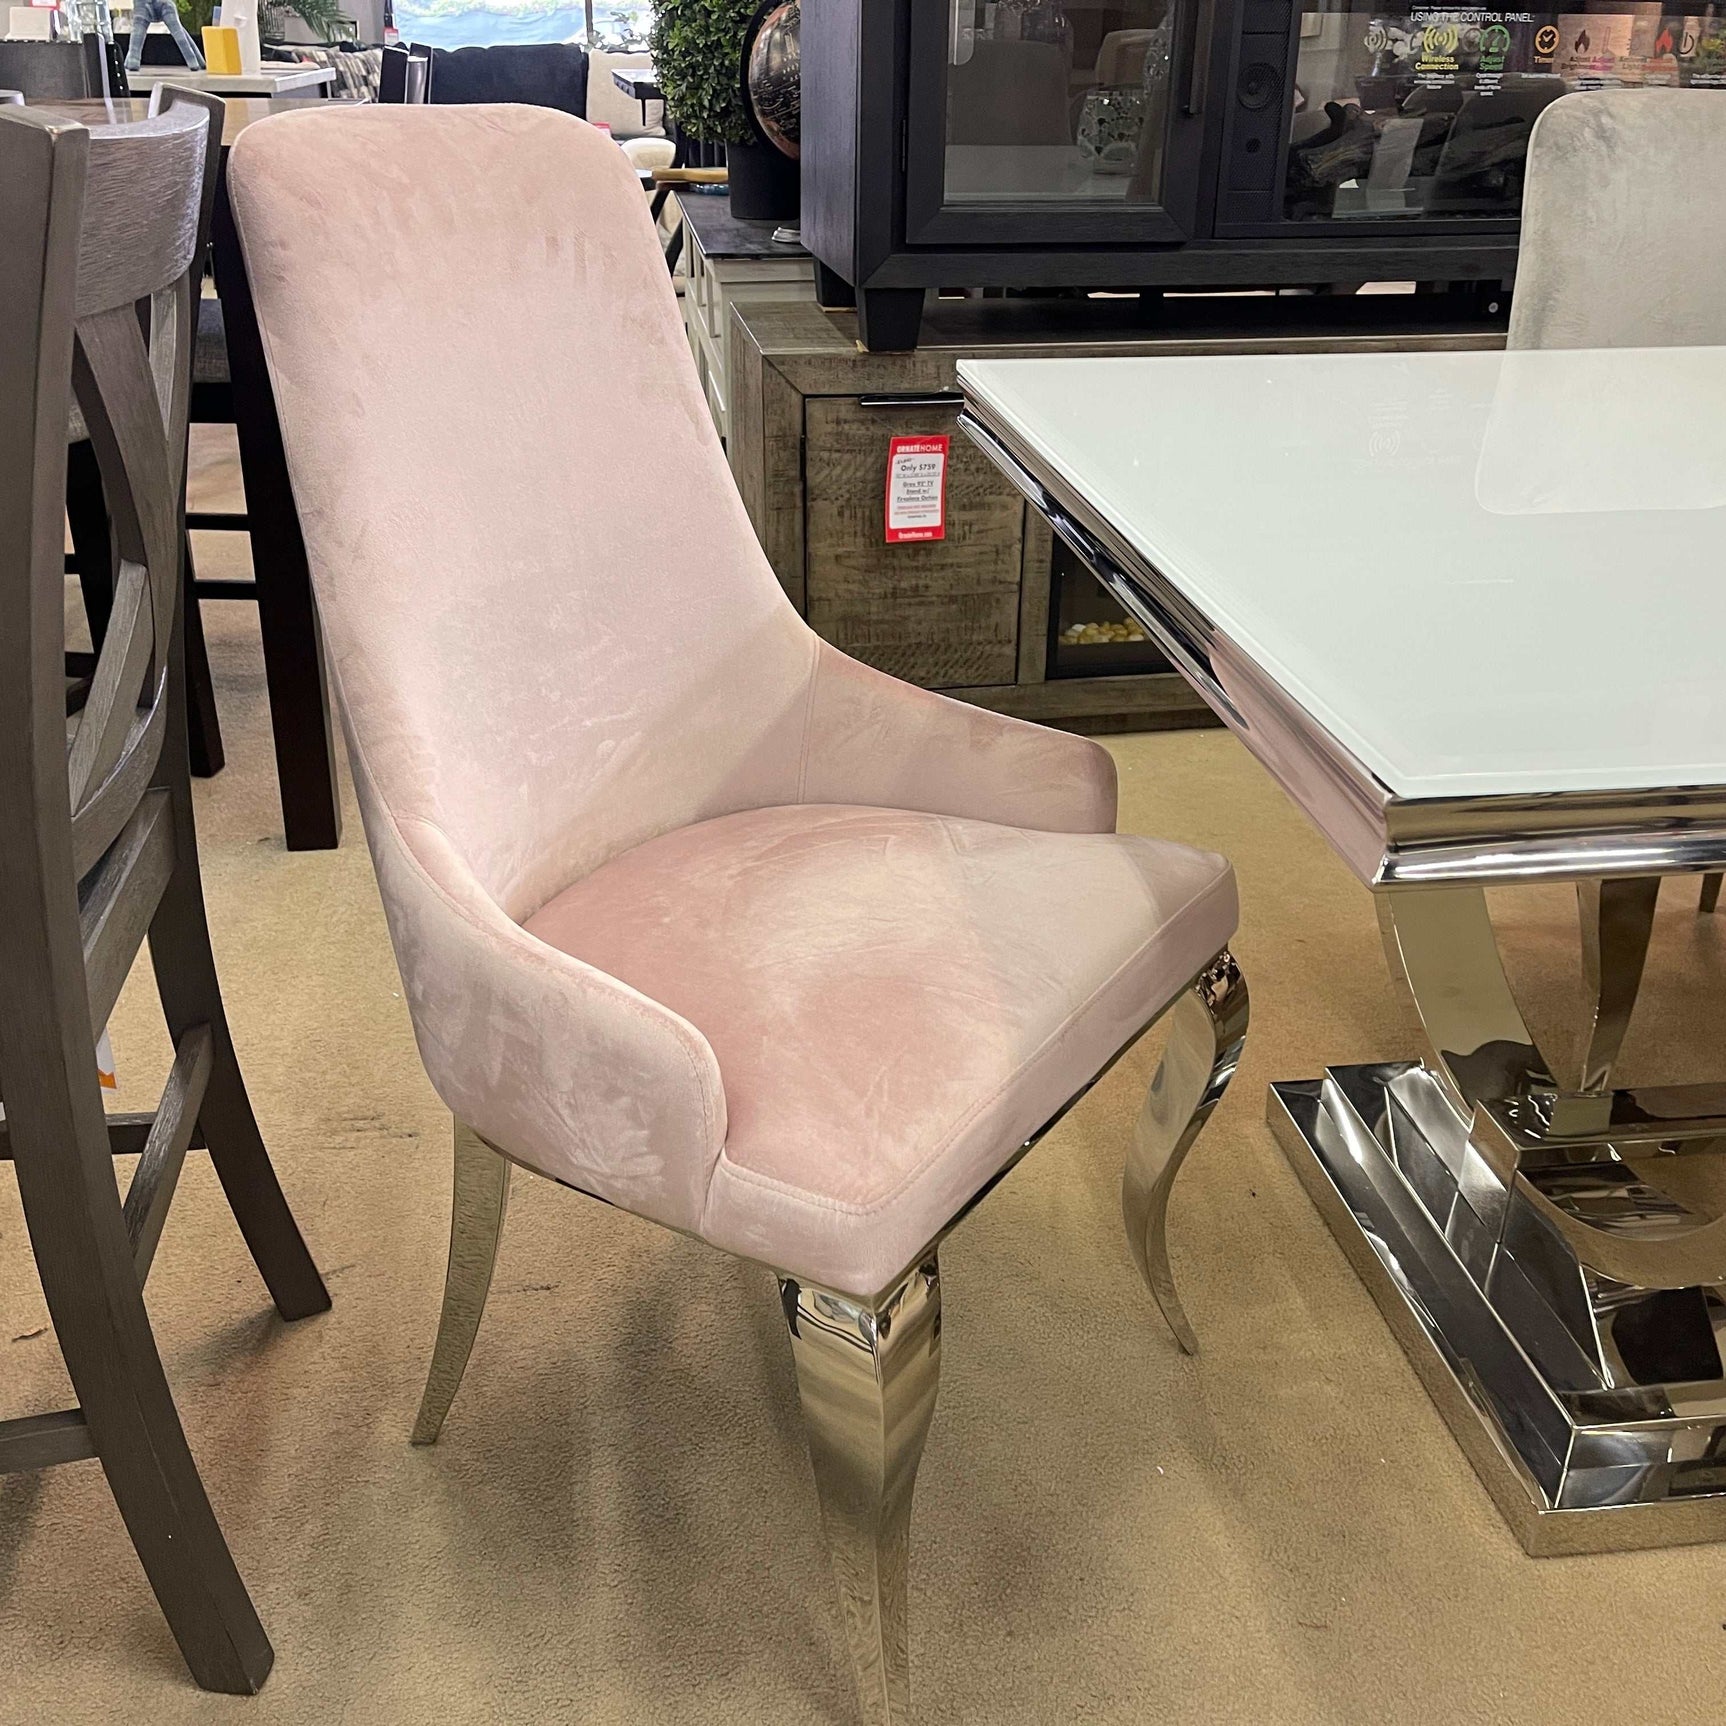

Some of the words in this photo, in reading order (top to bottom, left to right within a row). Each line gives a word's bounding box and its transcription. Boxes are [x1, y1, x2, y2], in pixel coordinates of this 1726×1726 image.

[1411, 12, 1439, 22] USING
[1440, 12, 1460, 22] THE
[1460, 12, 1503, 22] CONTROL
[1422, 54, 1455, 63] Wireless
[1415, 62, 1459, 70] Connection
[901, 464, 917, 472] Only
[919, 463, 936, 471] $759
